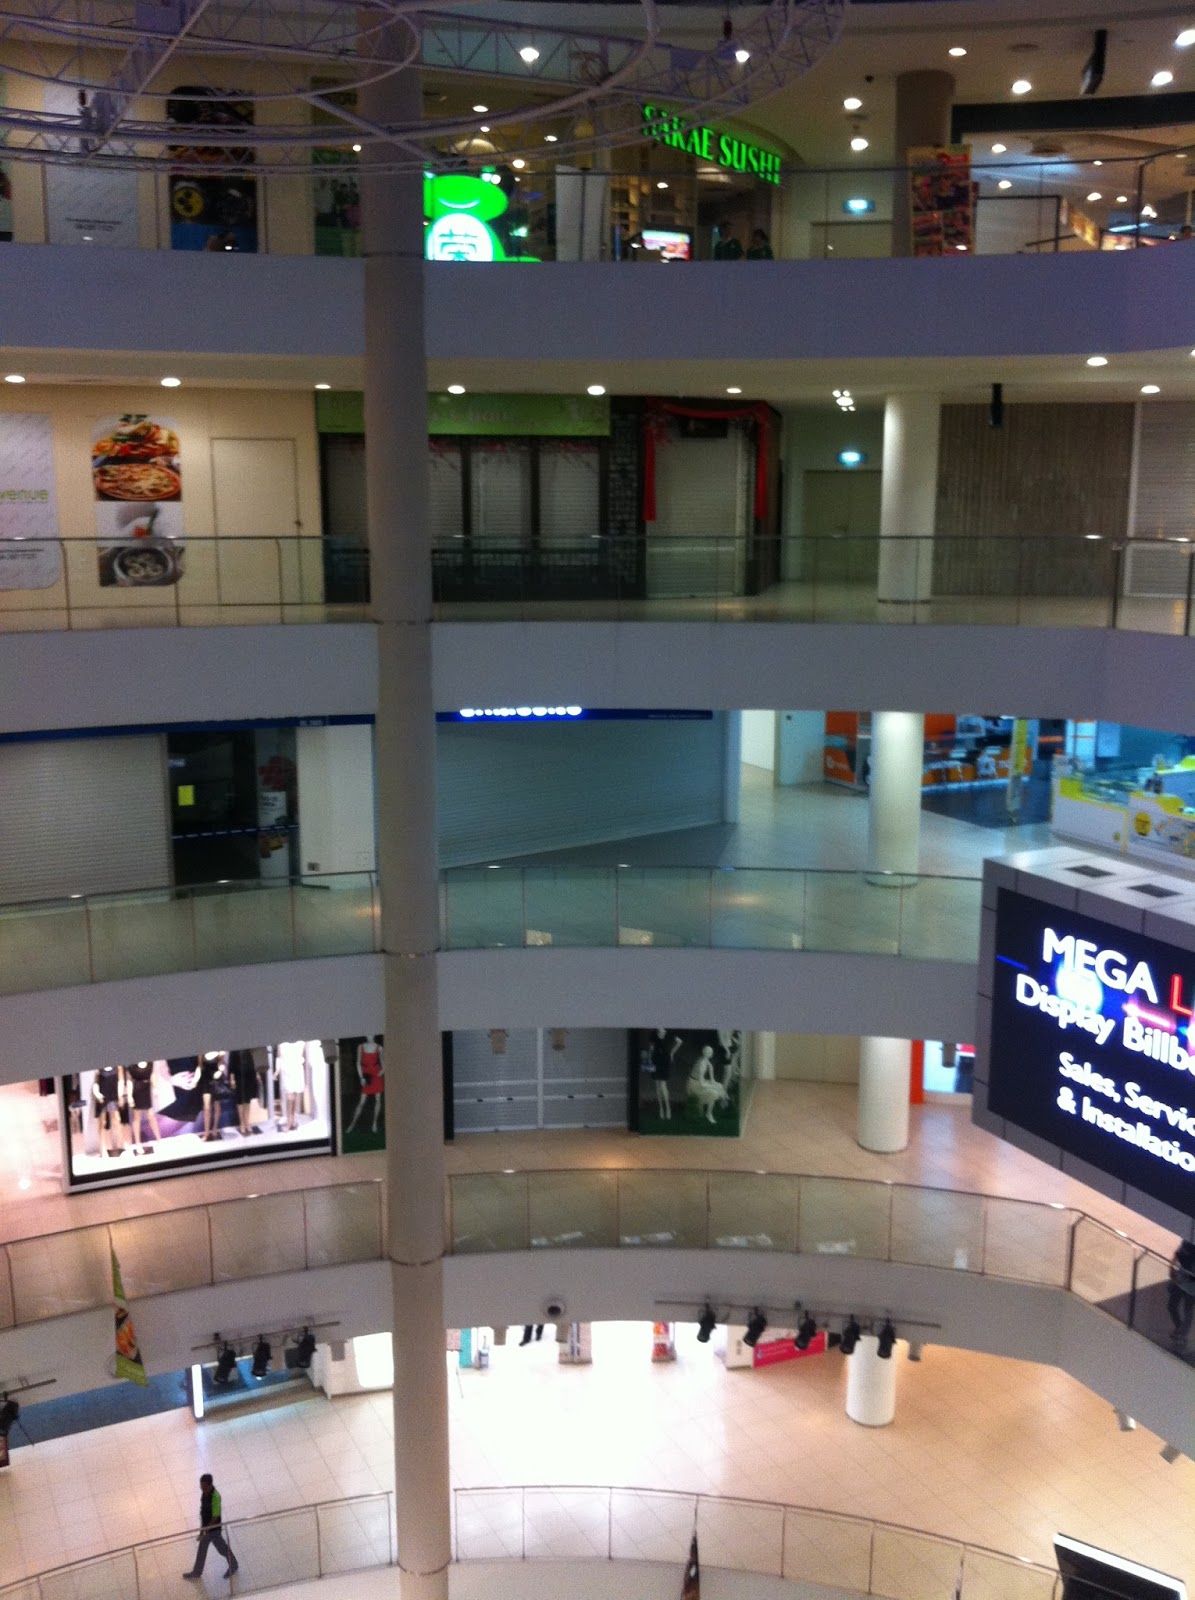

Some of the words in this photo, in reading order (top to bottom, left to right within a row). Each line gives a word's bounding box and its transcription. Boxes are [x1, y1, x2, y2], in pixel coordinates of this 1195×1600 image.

[718, 133, 781, 185] SUSHI
[1043, 927, 1159, 1004] MEGA
[1016, 973, 1115, 1045] Display
[1057, 1086, 1077, 1115] &
[1058, 1051, 1121, 1103] Sales,
